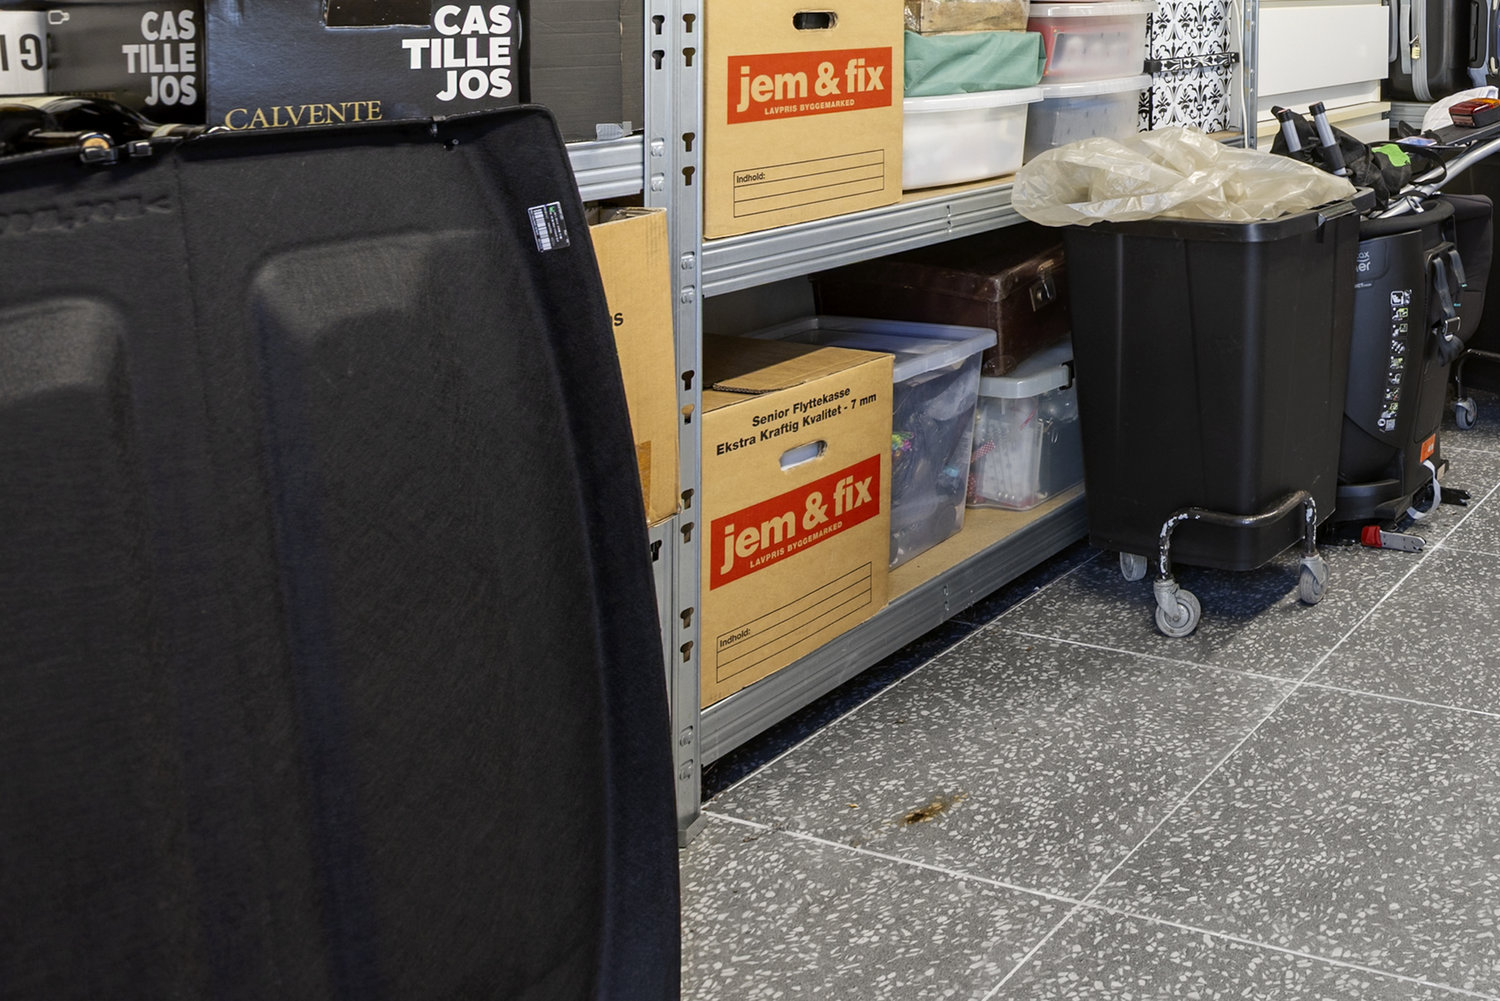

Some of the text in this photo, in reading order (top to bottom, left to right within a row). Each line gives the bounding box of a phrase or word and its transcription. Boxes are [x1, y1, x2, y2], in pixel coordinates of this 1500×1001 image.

[141, 9, 195, 41] CAS
[433, 4, 512, 36] CAS
[121, 43, 196, 74] TILLE
[401, 36, 511, 69] TILLE
[145, 75, 197, 106] JOS
[435, 67, 513, 101] JOS
[737, 58, 885, 112] jem & fix
[224, 100, 383, 131] CALVENTE
[764, 99, 855, 115] LAVPRIS BYGGEMARKED
[736, 172, 765, 183] Indhold:
[752, 387, 850, 428] Senior Flyttekasse
[716, 435, 756, 456] Ekstra
[760, 421, 799, 442] Kraftig
[802, 405, 841, 427] Kvalitet
[851, 399, 857, 409] 7
[859, 393, 877, 406] mm
[720, 475, 873, 575] jem & fix
[749, 521, 843, 569] LAVPRIS BYGGEMARKED
[720, 628, 751, 648] Indhold:
